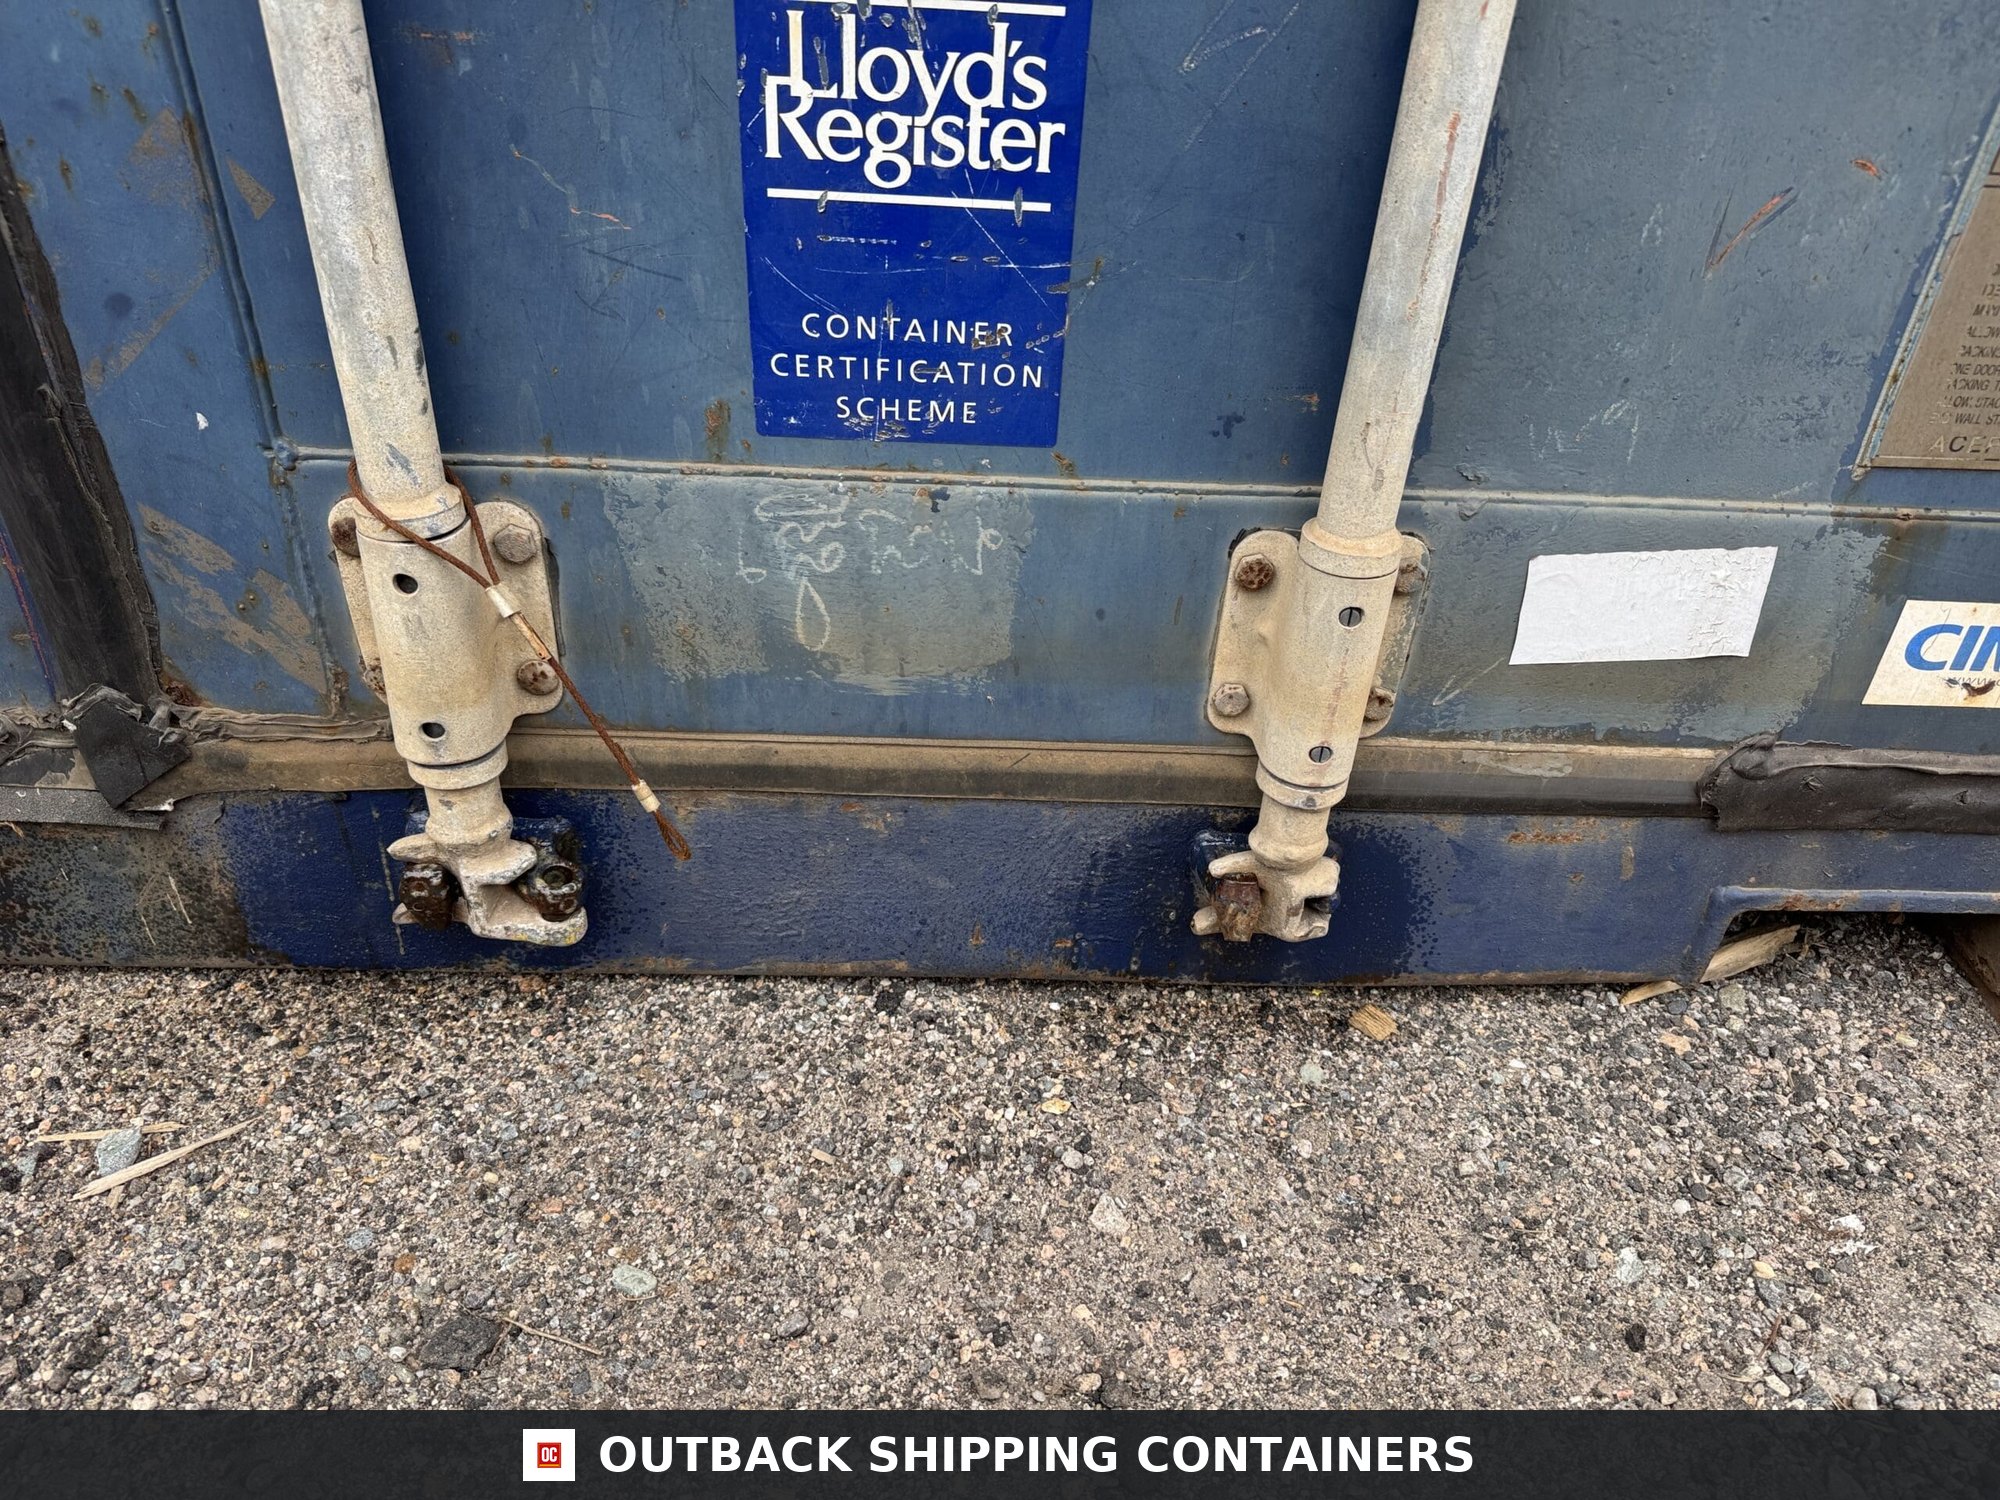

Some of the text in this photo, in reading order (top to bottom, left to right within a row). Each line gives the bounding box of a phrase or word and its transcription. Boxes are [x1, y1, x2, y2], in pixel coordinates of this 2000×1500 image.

[786, 9, 1049, 127] Lloyd's
[764, 75, 1066, 189] Register
[801, 312, 1014, 347] CONTAINER
[770, 353, 1043, 389] CERTIFICATION
[835, 396, 977, 424] SCHEME
[1954, 413, 1981, 426] WALL
